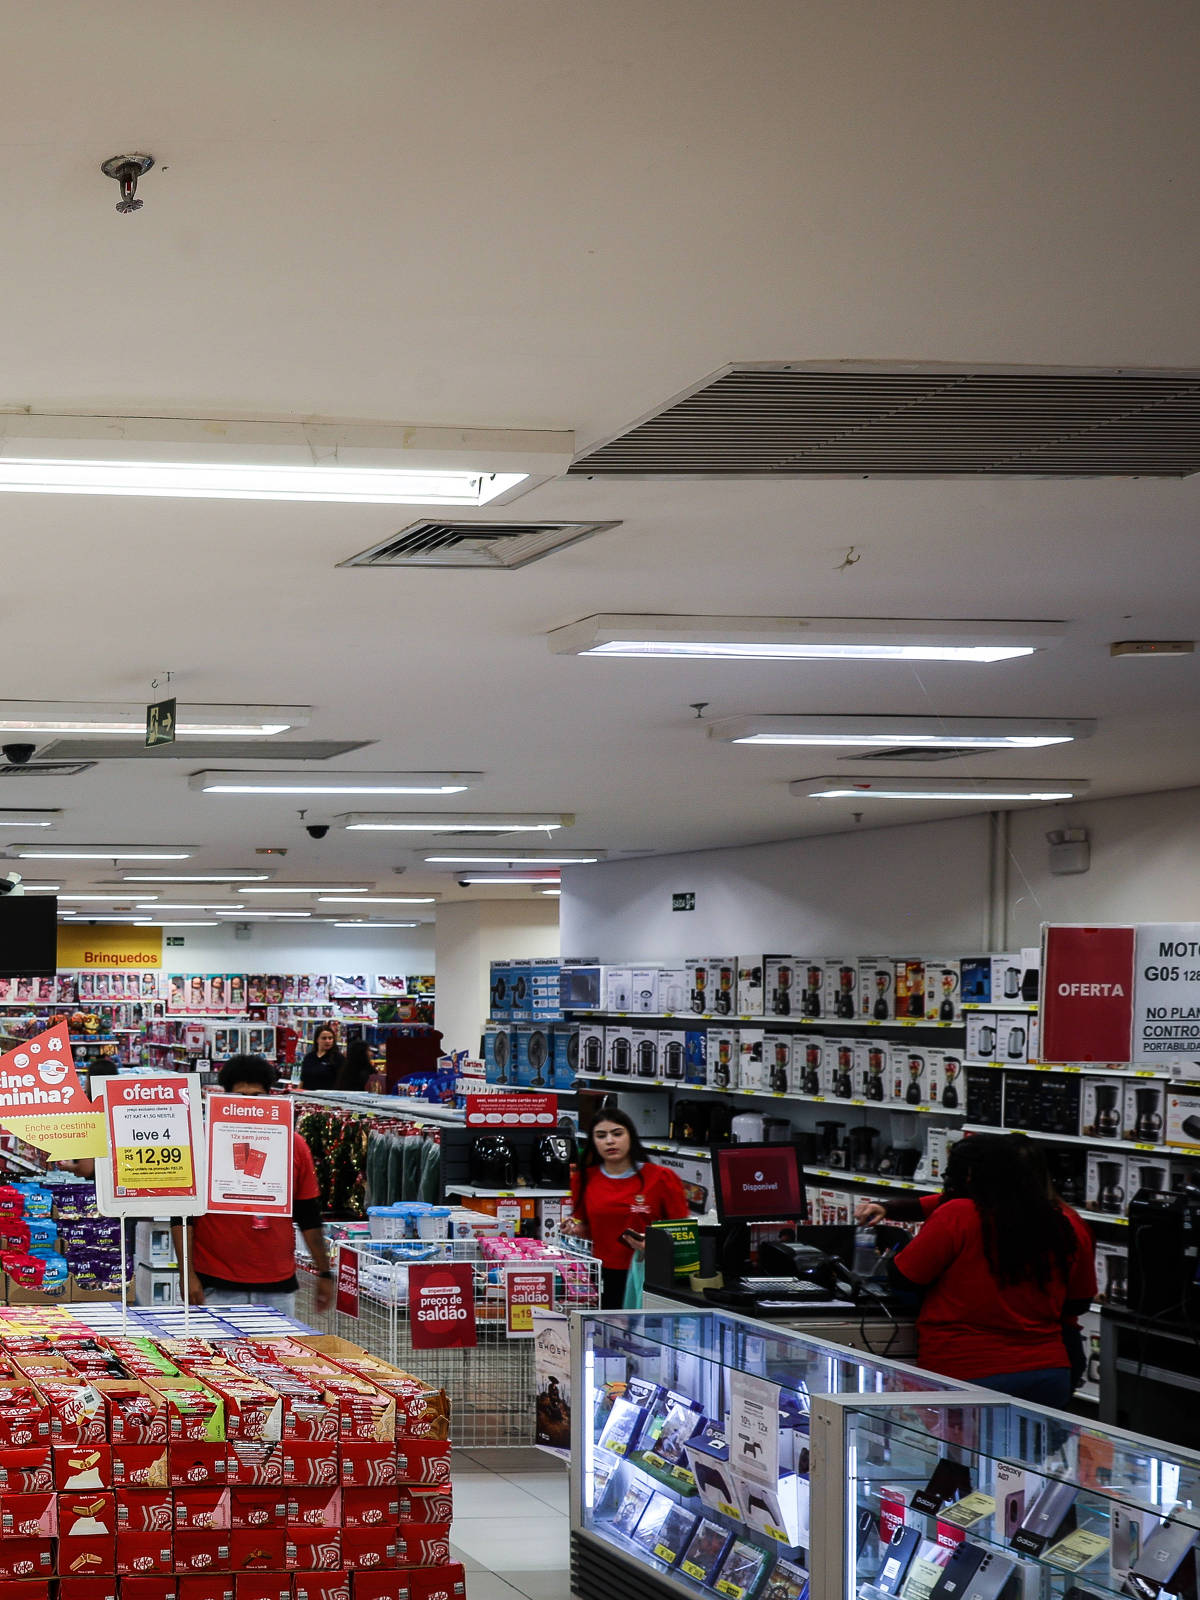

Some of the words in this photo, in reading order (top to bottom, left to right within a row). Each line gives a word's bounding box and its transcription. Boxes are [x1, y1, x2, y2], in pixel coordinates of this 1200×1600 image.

[1159, 942, 1200, 957] MOT
[85, 951, 158, 965] Brinquedos
[1144, 966, 1179, 981] G05
[1058, 983, 1125, 997] OFERTA
[1146, 1007, 1167, 1019] NO
[1143, 1026, 1200, 1037] CONTRO
[123, 1084, 175, 1101] oferta
[222, 1104, 264, 1117] cliente
[25, 1124, 49, 1132] Enche
[61, 1122, 96, 1130] cestinha
[38, 1131, 88, 1141] gostosuras!
[132, 1129, 159, 1142] leve
[163, 1129, 171, 1140] 4
[136, 1148, 182, 1166] 12,99
[742, 1181, 779, 1192] Disponível
[338, 1281, 358, 1297] saldão
[514, 1284, 535, 1293] preço
[420, 1296, 447, 1308] preço
[450, 1294, 462, 1304] de
[511, 1291, 549, 1302] saldão
[417, 1305, 467, 1321] saldão
[997, 1462, 1022, 1478] Galaxy
[916, 1497, 936, 1509] Galaxy
[1017, 1536, 1039, 1549] Galaxy
